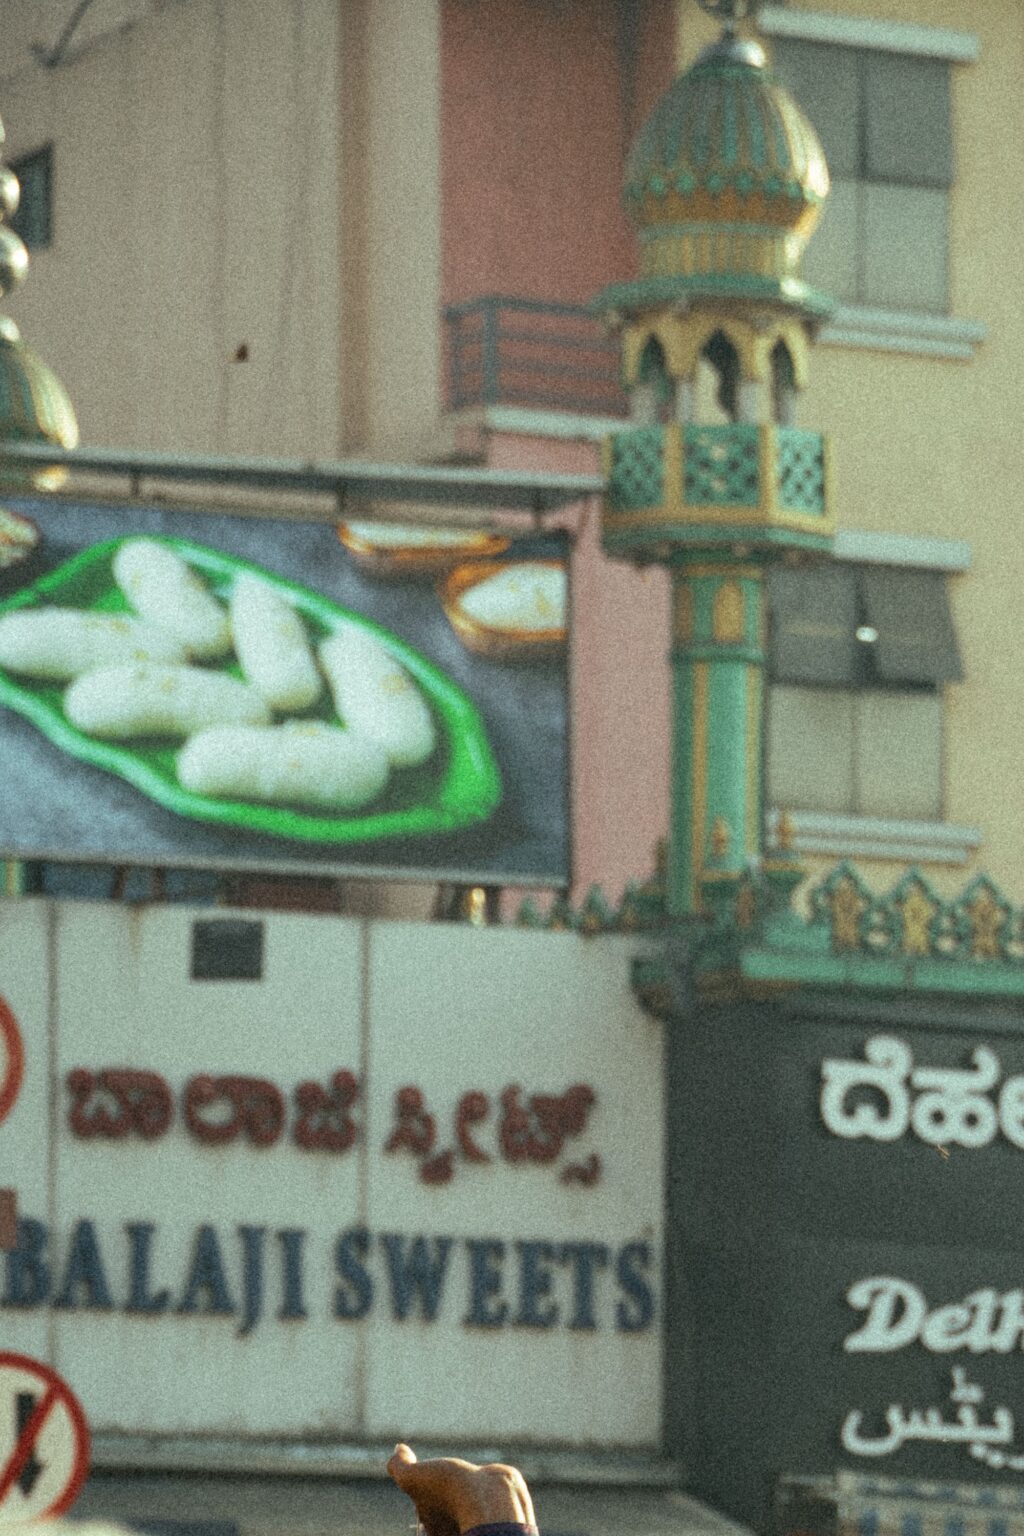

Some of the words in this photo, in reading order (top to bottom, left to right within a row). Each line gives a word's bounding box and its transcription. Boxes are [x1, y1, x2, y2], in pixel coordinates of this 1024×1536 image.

[65, 1067, 361, 1155] ಬಾಲಾಜಿ
[0, 1214, 309, 1339] BALAJI
[332, 1224, 656, 1334] SWEETS
